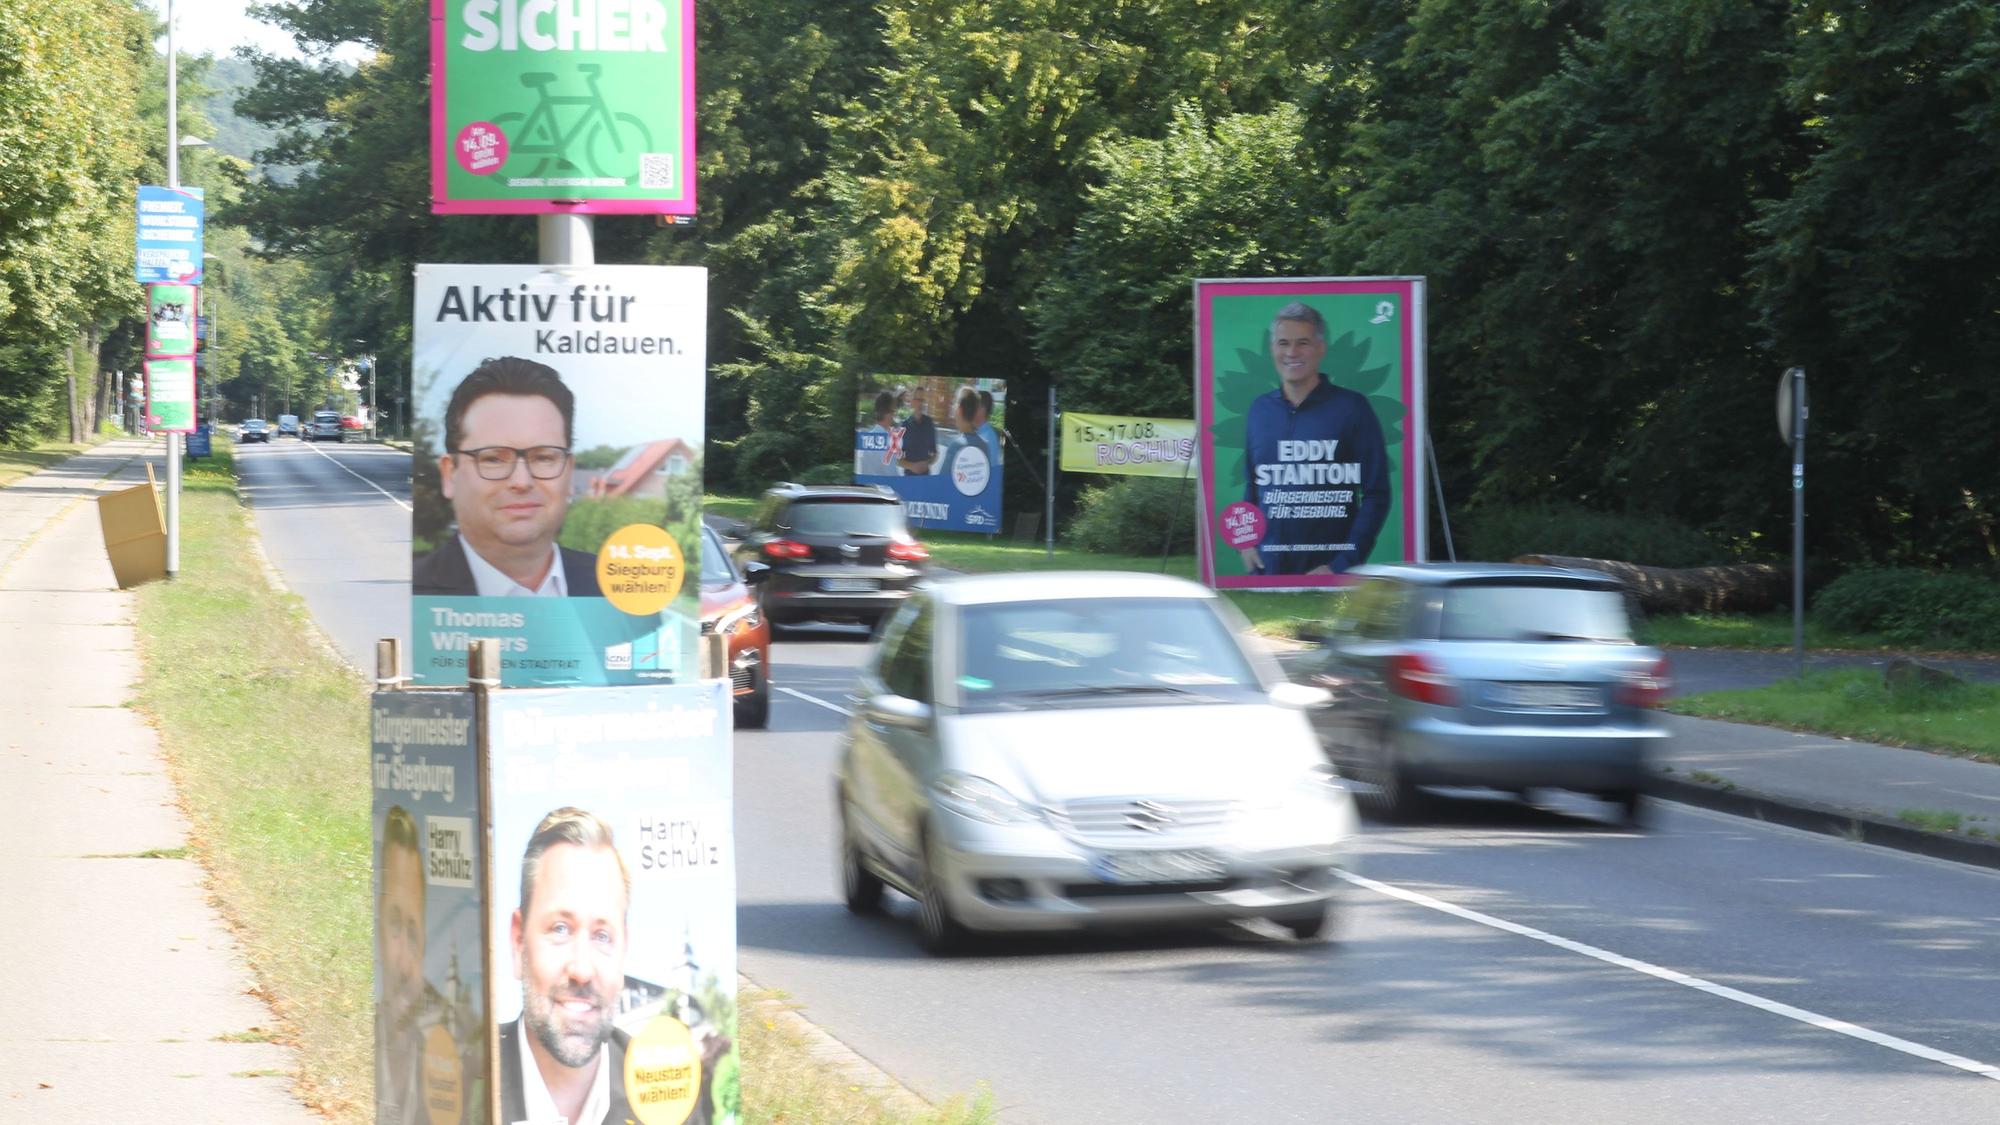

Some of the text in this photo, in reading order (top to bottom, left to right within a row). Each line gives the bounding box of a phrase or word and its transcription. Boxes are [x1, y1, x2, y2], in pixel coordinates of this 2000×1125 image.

[462, 0, 668, 52] SICHER
[436, 284, 635, 322] Aktiv für
[536, 330, 682, 355] Kaldauen.
[1096, 438, 1194, 466] ROCHUS
[1278, 439, 1339, 461] EDDY
[1254, 463, 1361, 485] STANTON
[1264, 488, 1353, 504] BÜRGERMEISTER
[1224, 511, 1258, 529] 14.09.
[1269, 504, 1348, 519] FÜR SIEGBURG.
[608, 544, 674, 562] 14. Sept.
[607, 563, 676, 579] Siegburg
[610, 579, 671, 593] wählen!
[431, 607, 524, 628] Thomas
[431, 631, 528, 652] Wilers
[431, 655, 454, 668] FÜR
[500, 658, 517, 669] EN
[519, 659, 581, 669] STADTRAT
[374, 707, 469, 753] Bürgermeister
[374, 753, 455, 803] für Siegburg
[430, 822, 461, 857] Harry
[639, 817, 702, 844] Harry
[430, 851, 472, 880] Schulz
[640, 843, 720, 871] Schulz
[635, 1064, 692, 1085] Neustart
